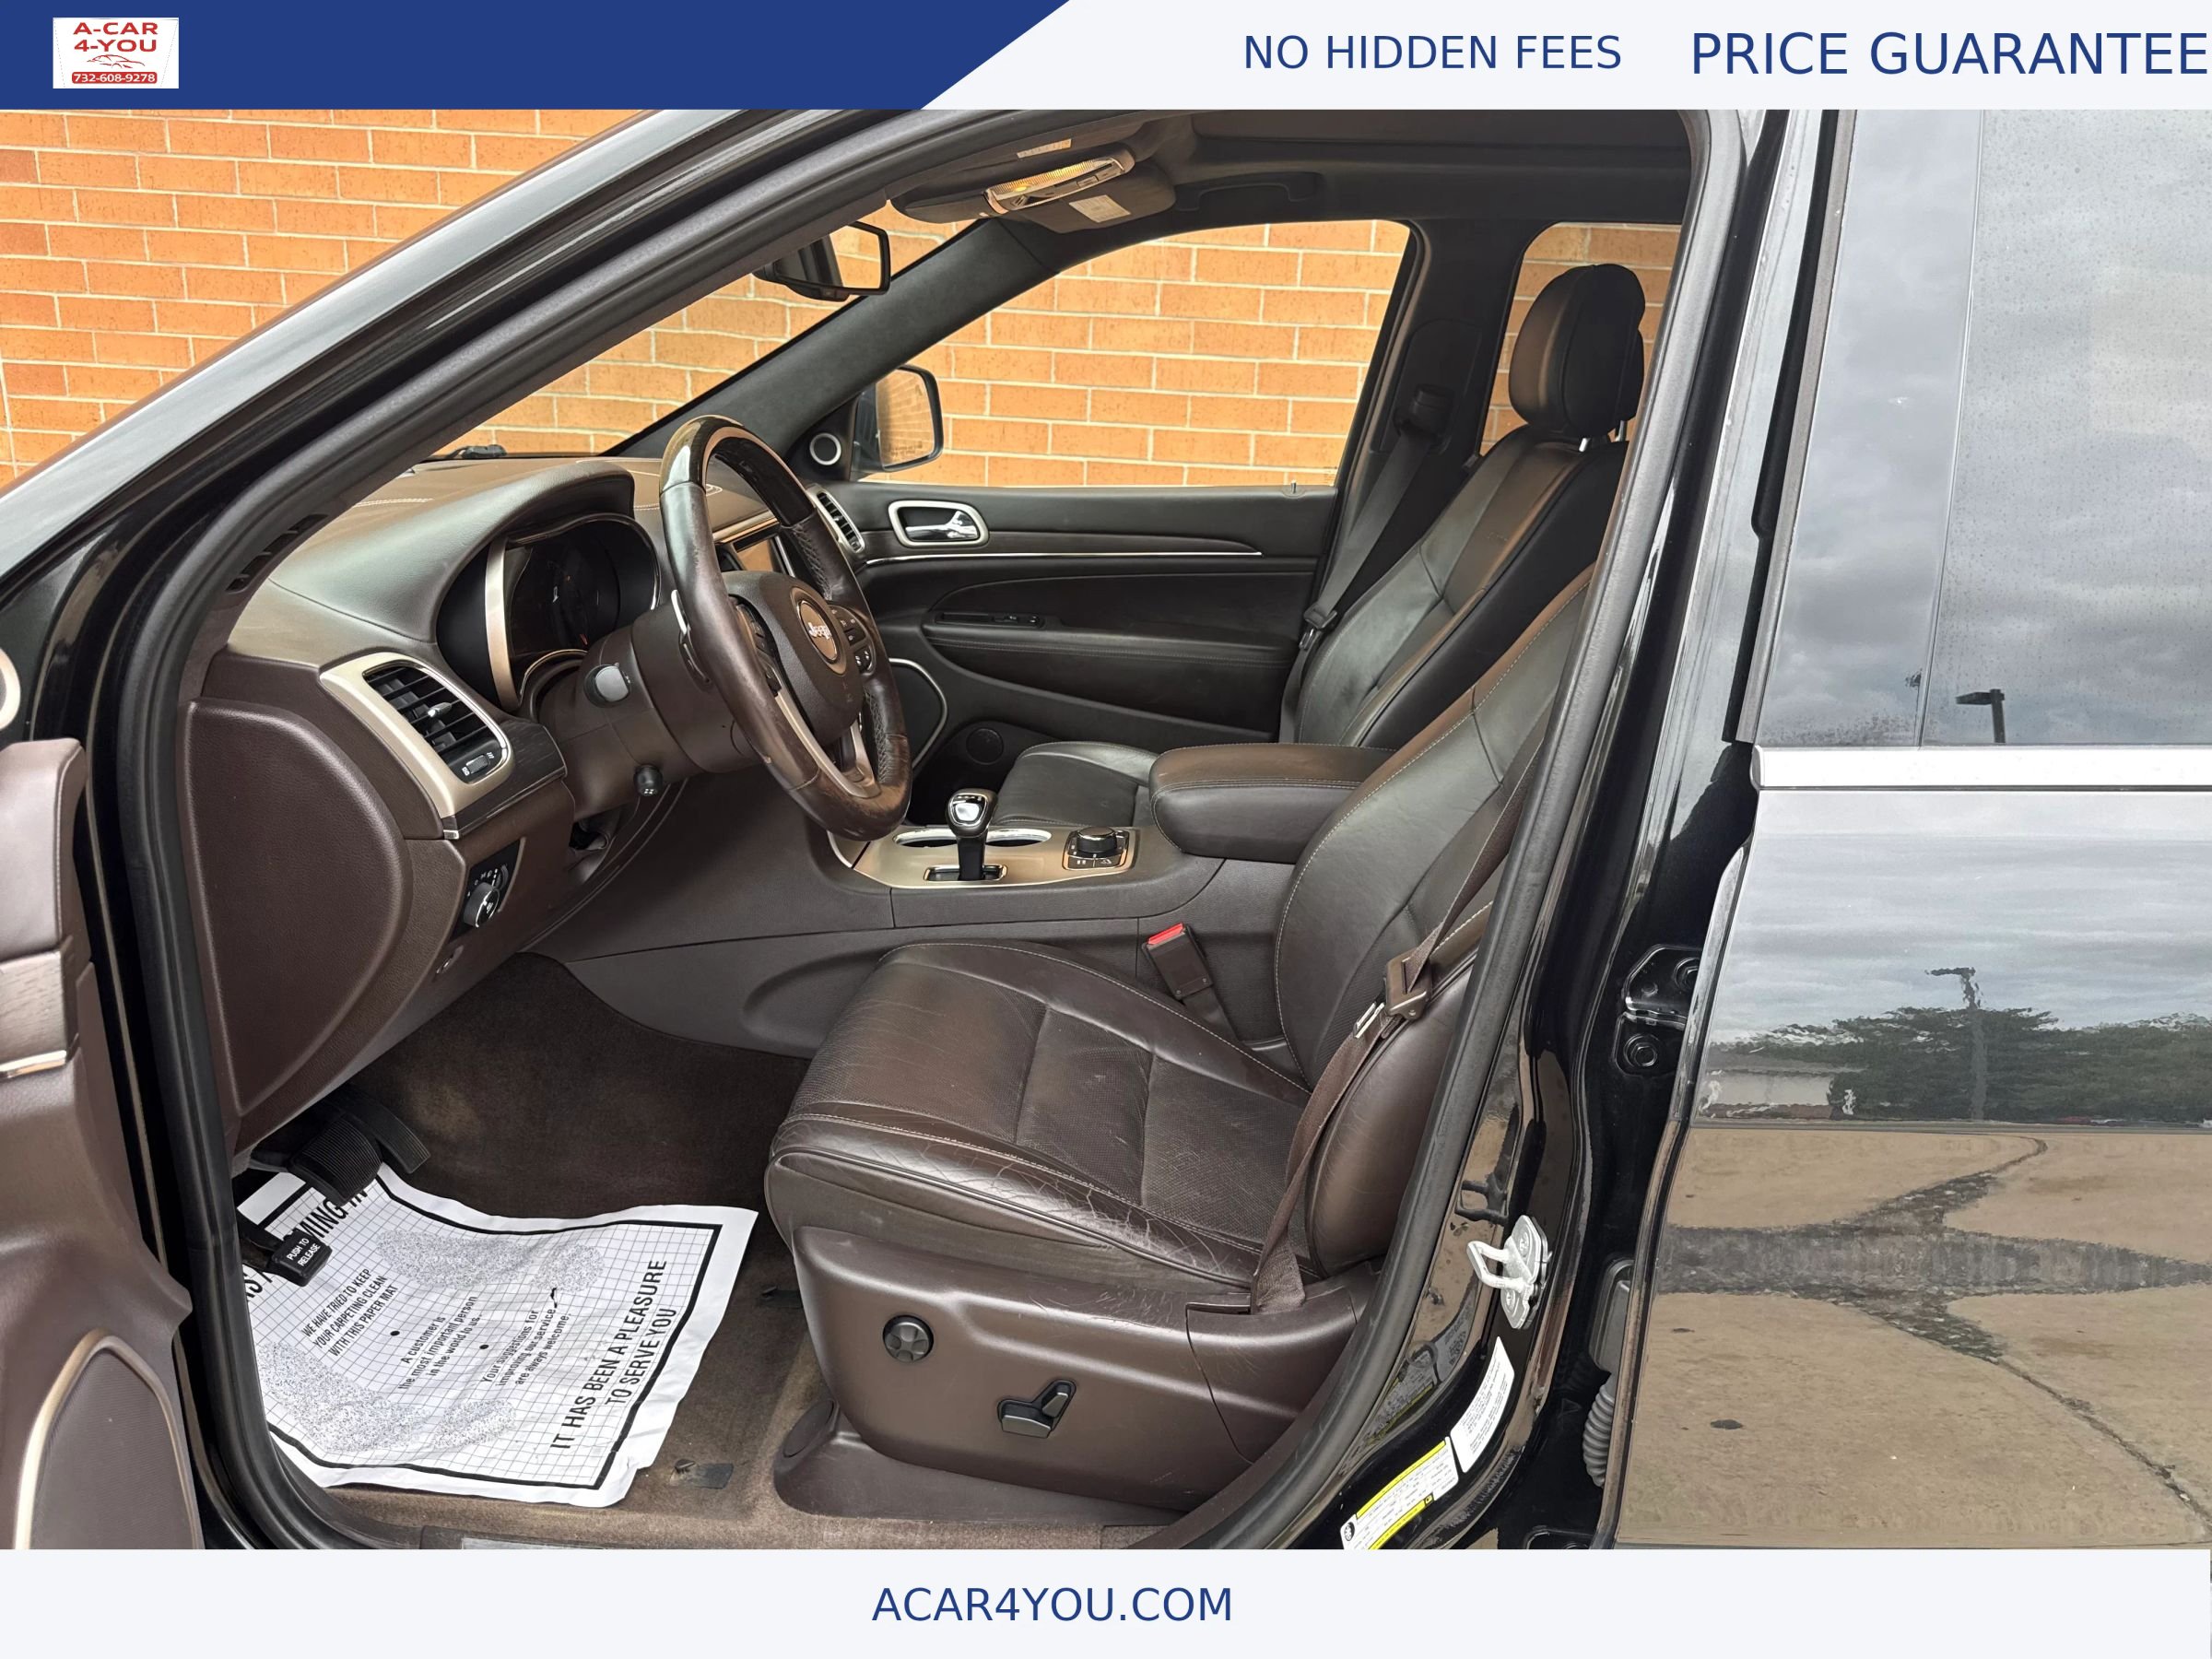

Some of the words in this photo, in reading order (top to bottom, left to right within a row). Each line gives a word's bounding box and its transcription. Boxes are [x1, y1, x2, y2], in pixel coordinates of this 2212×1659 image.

[286, 1244, 303, 1261] PUSH
[300, 1238, 310, 1247] TO
[297, 1243, 321, 1266] RELEASE
[301, 1324, 317, 1336] WE
[312, 1309, 332, 1328] HAVE
[326, 1292, 347, 1313] TRIED
[343, 1285, 358, 1297] TO
[351, 1268, 371, 1288] KEEP
[312, 1329, 335, 1348] YOUR
[330, 1297, 367, 1333] CARPETING
[362, 1276, 387, 1298] CLEAN
[614, 1260, 667, 1340] PLEASURE
[328, 1336, 350, 1357] WITH
[344, 1322, 365, 1339] THIS
[359, 1300, 385, 1324] PAPER
[379, 1285, 398, 1301] MAT
[398, 1379, 415, 1390] the
[411, 1357, 431, 1377] most
[424, 1323, 458, 1356] important
[454, 1296, 477, 1323] person
[408, 1324, 440, 1356] customer
[433, 1356, 450, 1368] the
[446, 1334, 466, 1355] world
[479, 1364, 501, 1382] Your
[496, 1325, 533, 1364] suggestions
[524, 1310, 538, 1324] for
[607, 1346, 629, 1355] A
[495, 1352, 532, 1386] improving
[524, 1340, 538, 1352] our
[515, 1373, 530, 1384] are
[525, 1351, 547, 1371] always
[605, 1388, 632, 1406] TO
[619, 1340, 660, 1384] SERVE
[645, 1309, 677, 1336] YOU
[582, 1359, 621, 1392] BEEN
[561, 1395, 596, 1429] HAS
[550, 1433, 575, 1449] IT
